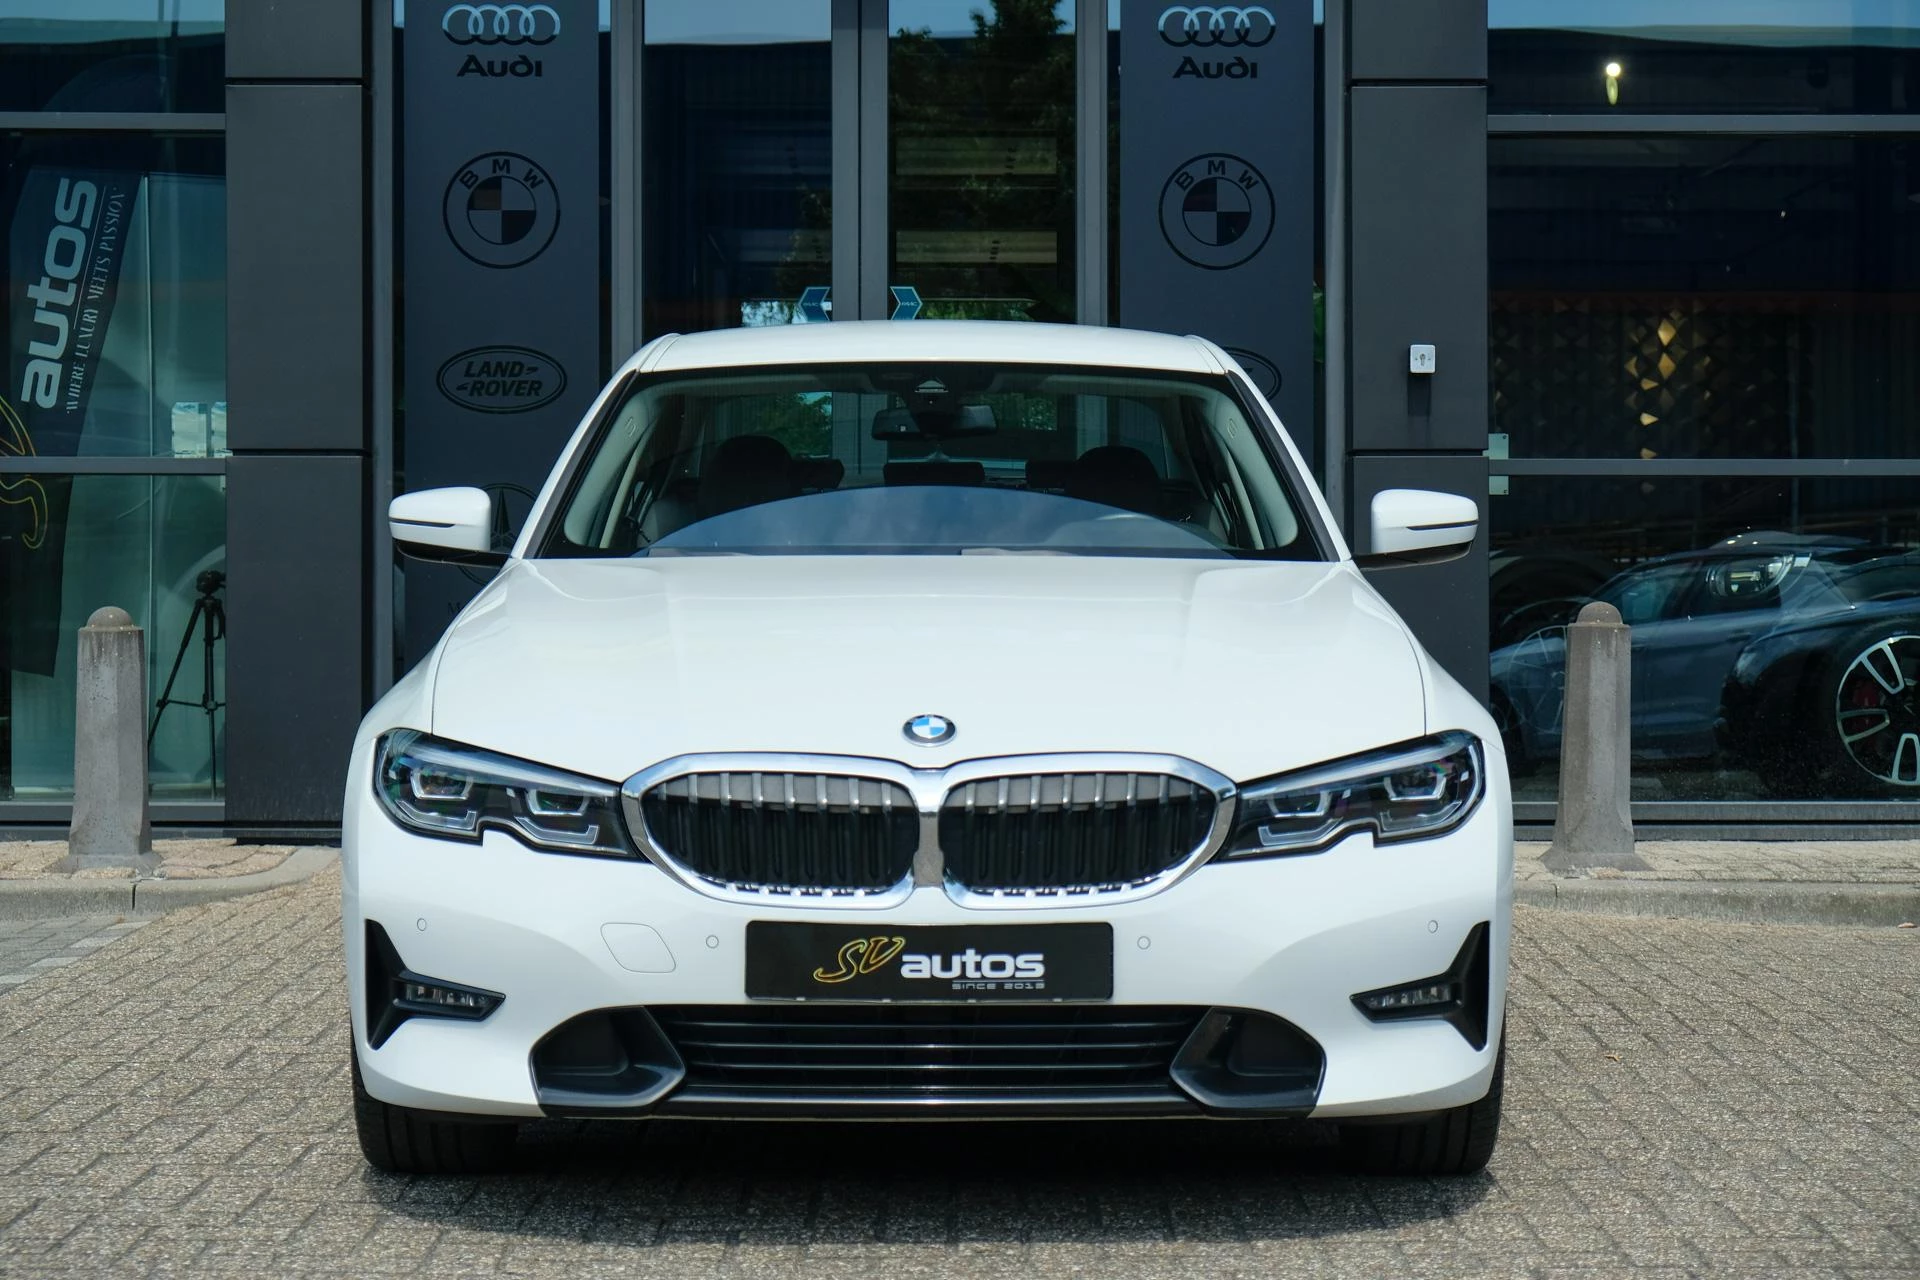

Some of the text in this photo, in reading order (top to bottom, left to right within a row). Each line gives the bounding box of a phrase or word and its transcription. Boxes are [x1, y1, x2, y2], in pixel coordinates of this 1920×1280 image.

[457, 54, 542, 77] Audi
[1172, 56, 1258, 79] Audi
[459, 159, 544, 190] BMW
[1174, 160, 1260, 191] BMW
[20, 177, 98, 409] autos
[86, 256, 111, 302] MEETS
[76, 308, 99, 359] LUXURY
[464, 361, 525, 378] LAND
[468, 380, 543, 397] ROVER
[813, 937, 1045, 983] SV autos
[951, 982, 996, 990] SINCE
